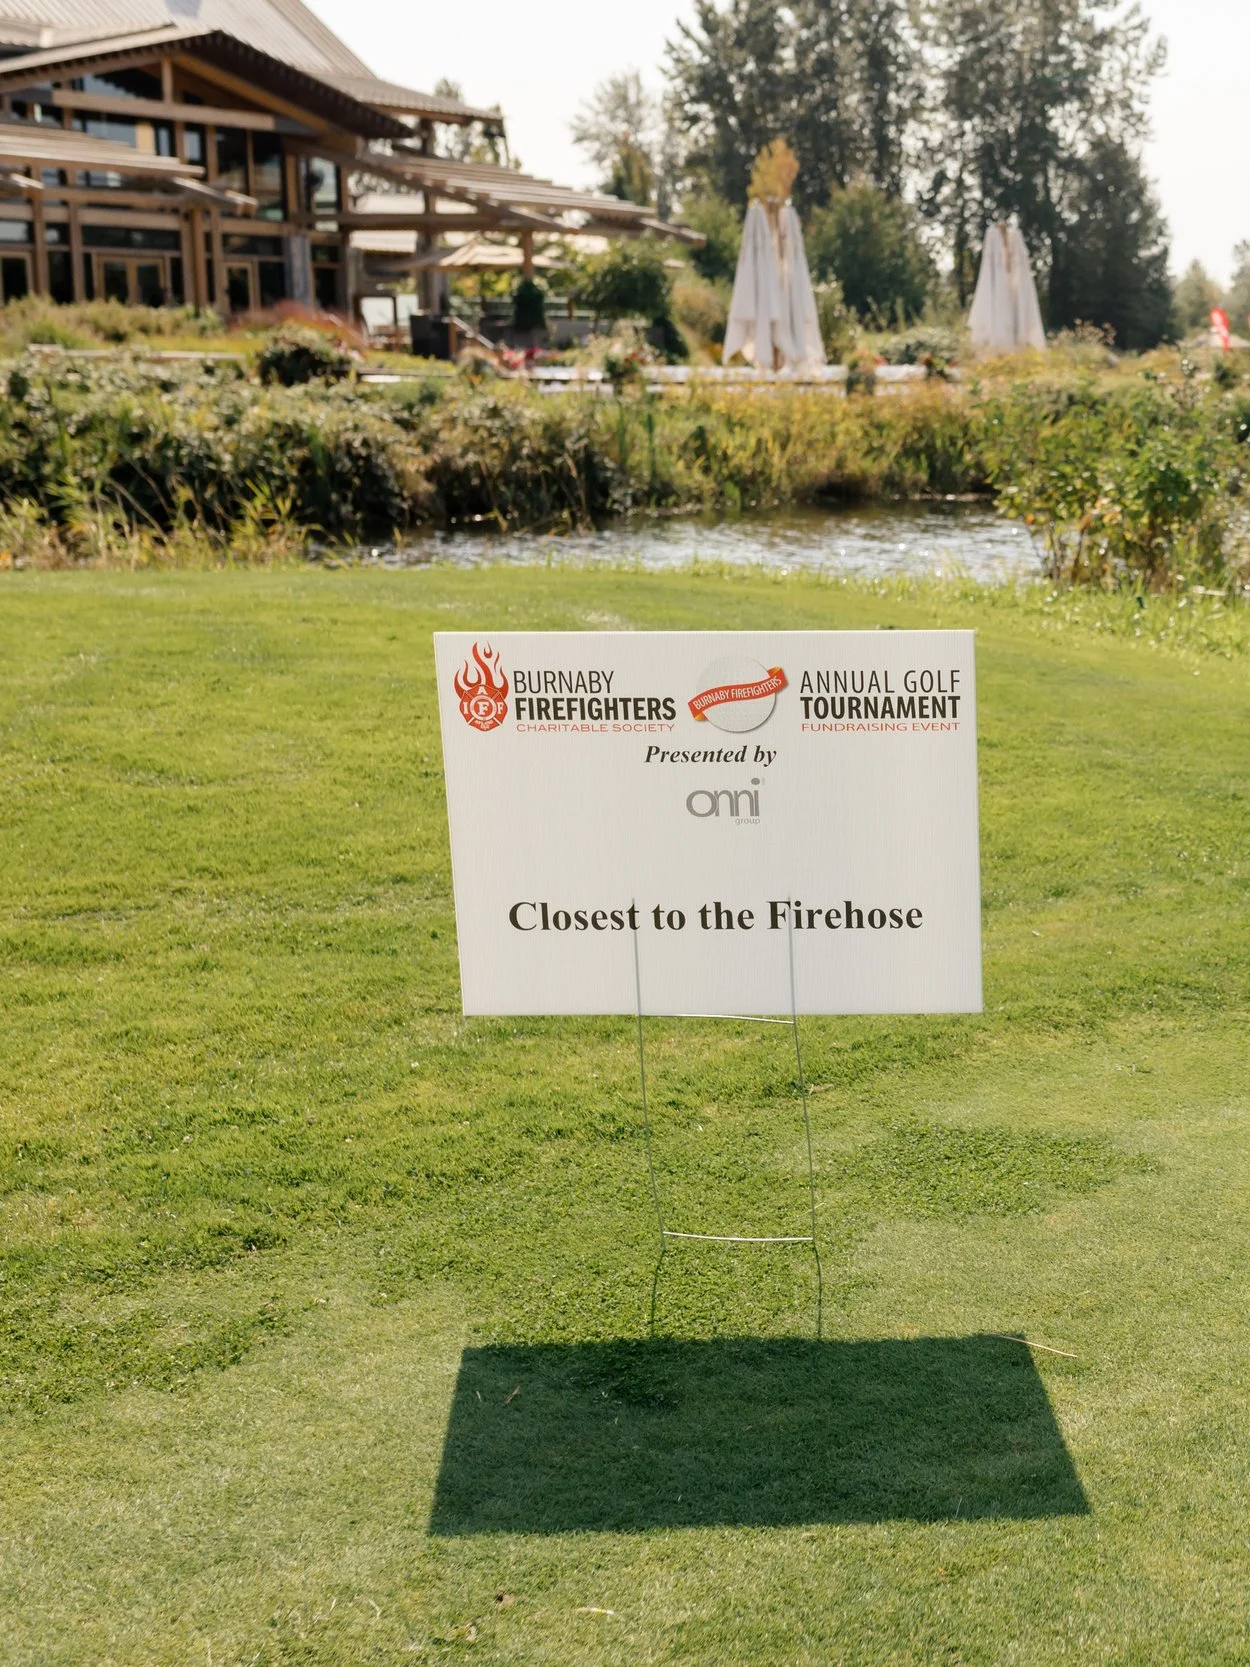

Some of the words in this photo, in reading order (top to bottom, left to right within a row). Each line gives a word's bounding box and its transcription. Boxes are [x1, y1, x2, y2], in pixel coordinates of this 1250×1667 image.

[513, 670, 614, 694] BURNABY
[693, 689, 730, 710] BURNABY
[731, 675, 782, 699] FIREFIGHTERS
[800, 670, 895, 694] ANNUAL
[903, 670, 960, 693] GOLF
[515, 697, 677, 720] FIREFIGHTERS
[800, 696, 961, 719] TOURNAMENT
[516, 723, 608, 732] CHARITABLE
[612, 723, 675, 732] SOCIETY
[801, 723, 907, 731] FUNDRAISING
[912, 722, 961, 731] EVENT
[644, 745, 747, 763] Presented
[753, 745, 777, 767] by
[686, 777, 760, 817] onni
[508, 901, 640, 931] Closest
[652, 904, 686, 930] to
[697, 901, 755, 930] the
[766, 900, 923, 930] Firehose
